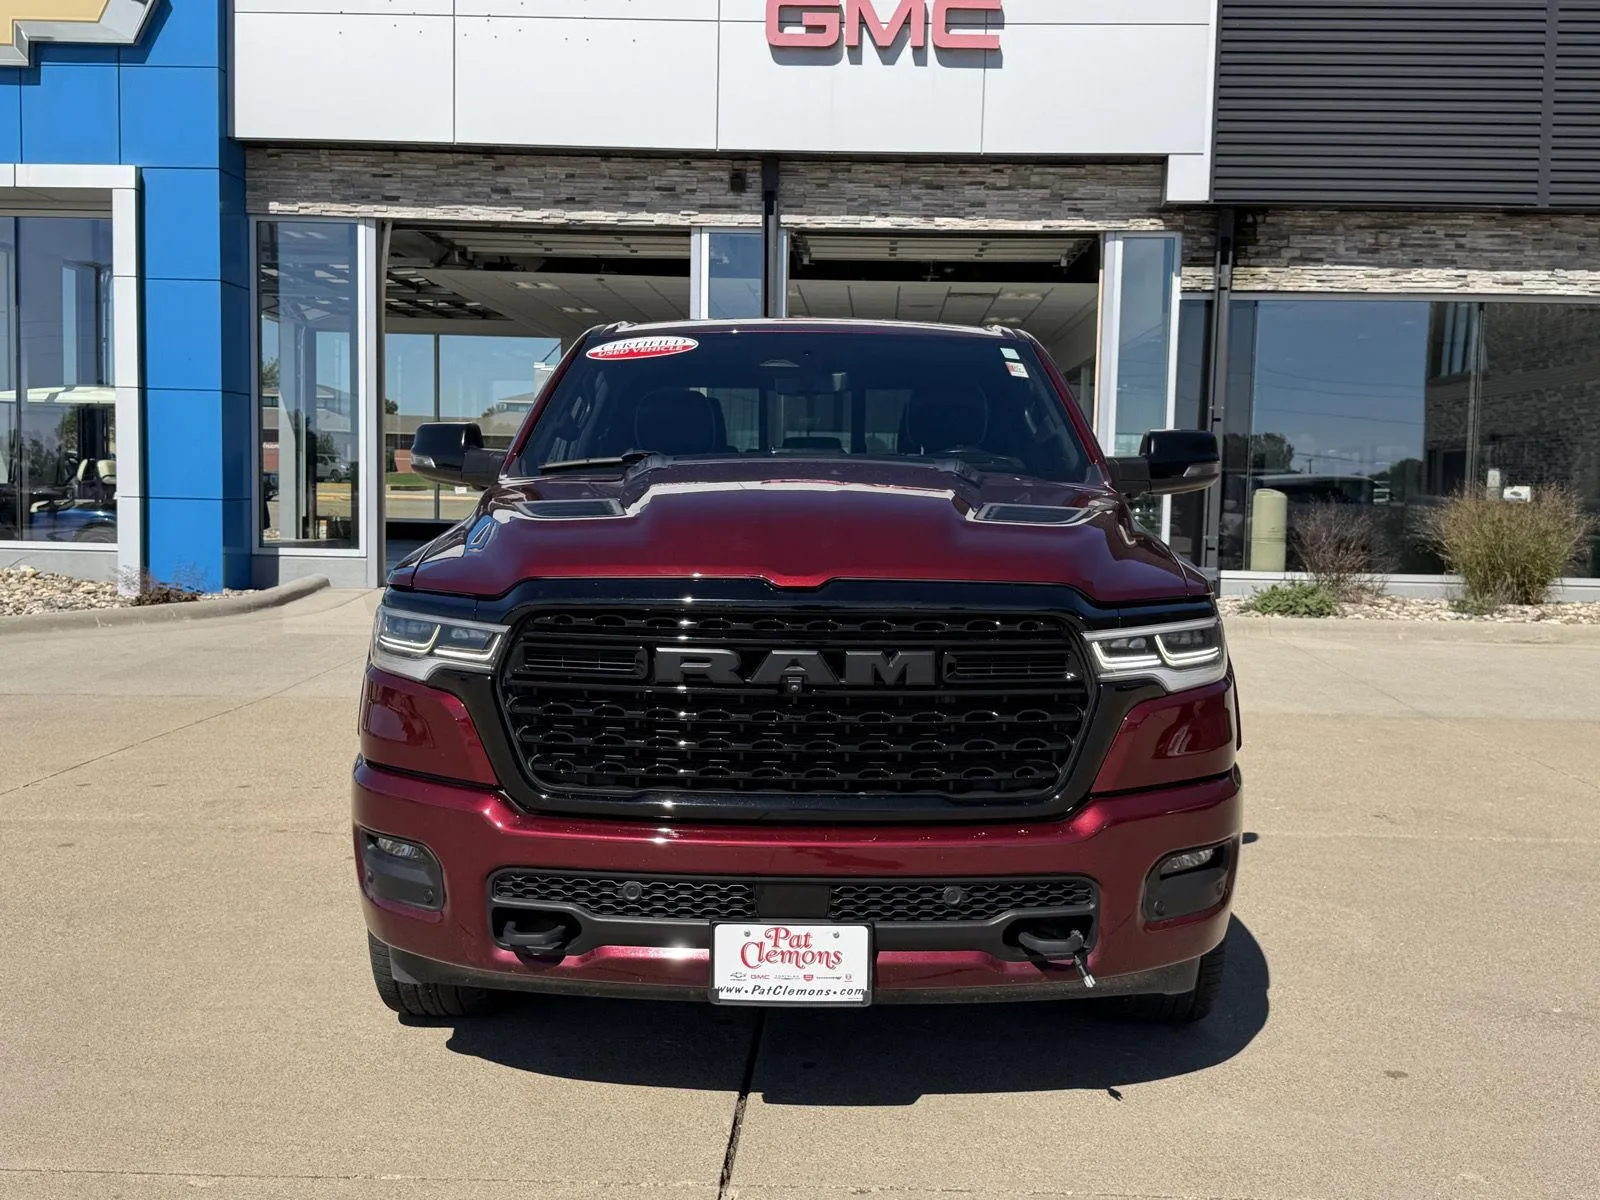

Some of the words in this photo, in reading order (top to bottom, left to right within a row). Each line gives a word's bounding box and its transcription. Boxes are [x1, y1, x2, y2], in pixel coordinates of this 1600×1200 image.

[766, 0, 1002, 49] GMC
[598, 349, 630, 357] USED
[633, 345, 684, 353] VEHICLE
[600, 338, 687, 351] CERTIFIED
[655, 647, 936, 685] RAM
[764, 926, 814, 949] Pat
[740, 941, 844, 970] Clemons
